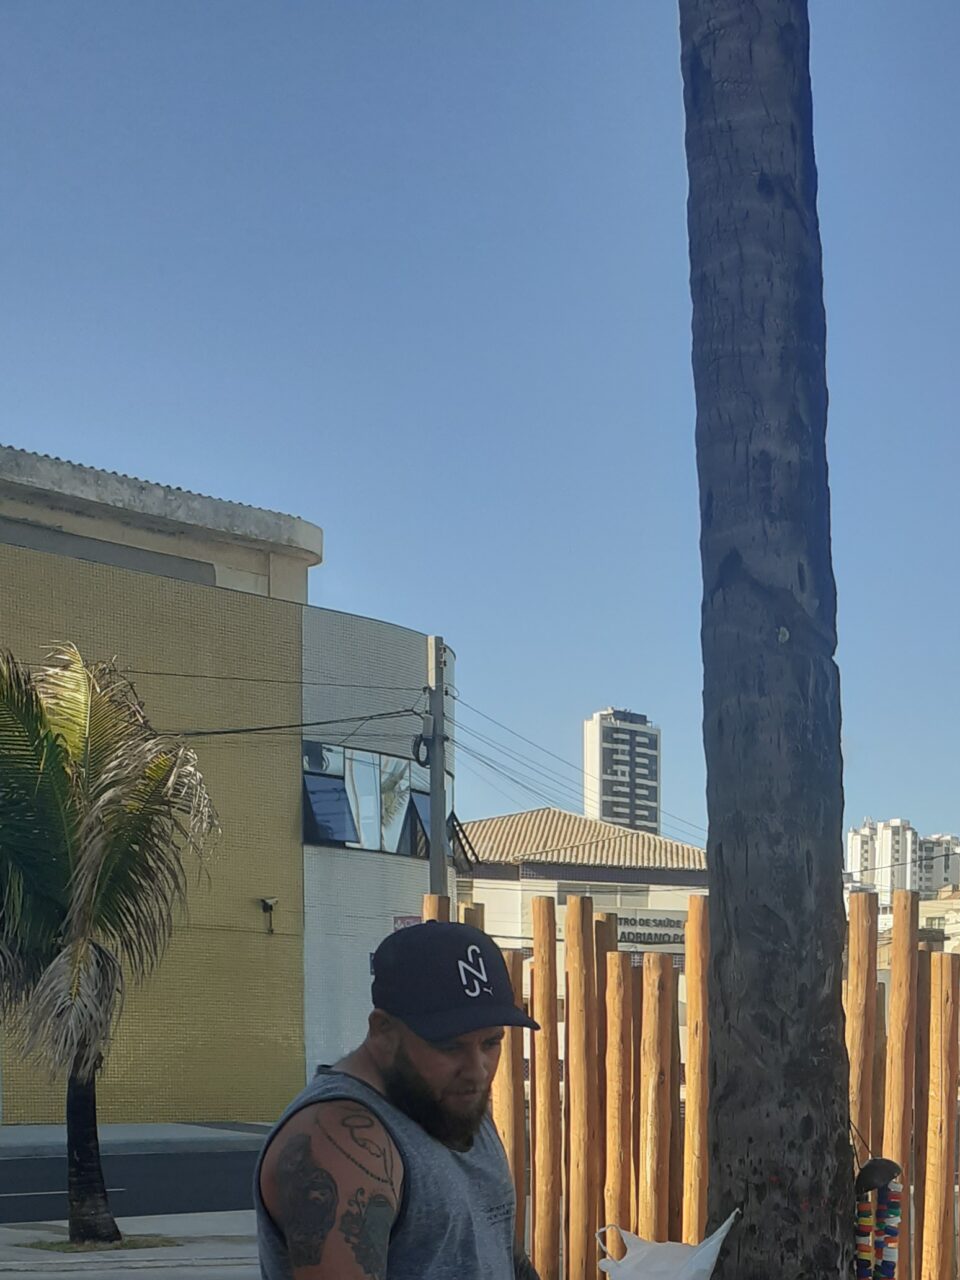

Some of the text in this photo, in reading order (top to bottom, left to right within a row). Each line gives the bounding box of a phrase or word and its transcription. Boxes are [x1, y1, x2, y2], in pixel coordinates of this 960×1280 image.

[618, 917, 682, 928] TRO DE SAÚDE
[620, 931, 671, 943] ADRIANO
